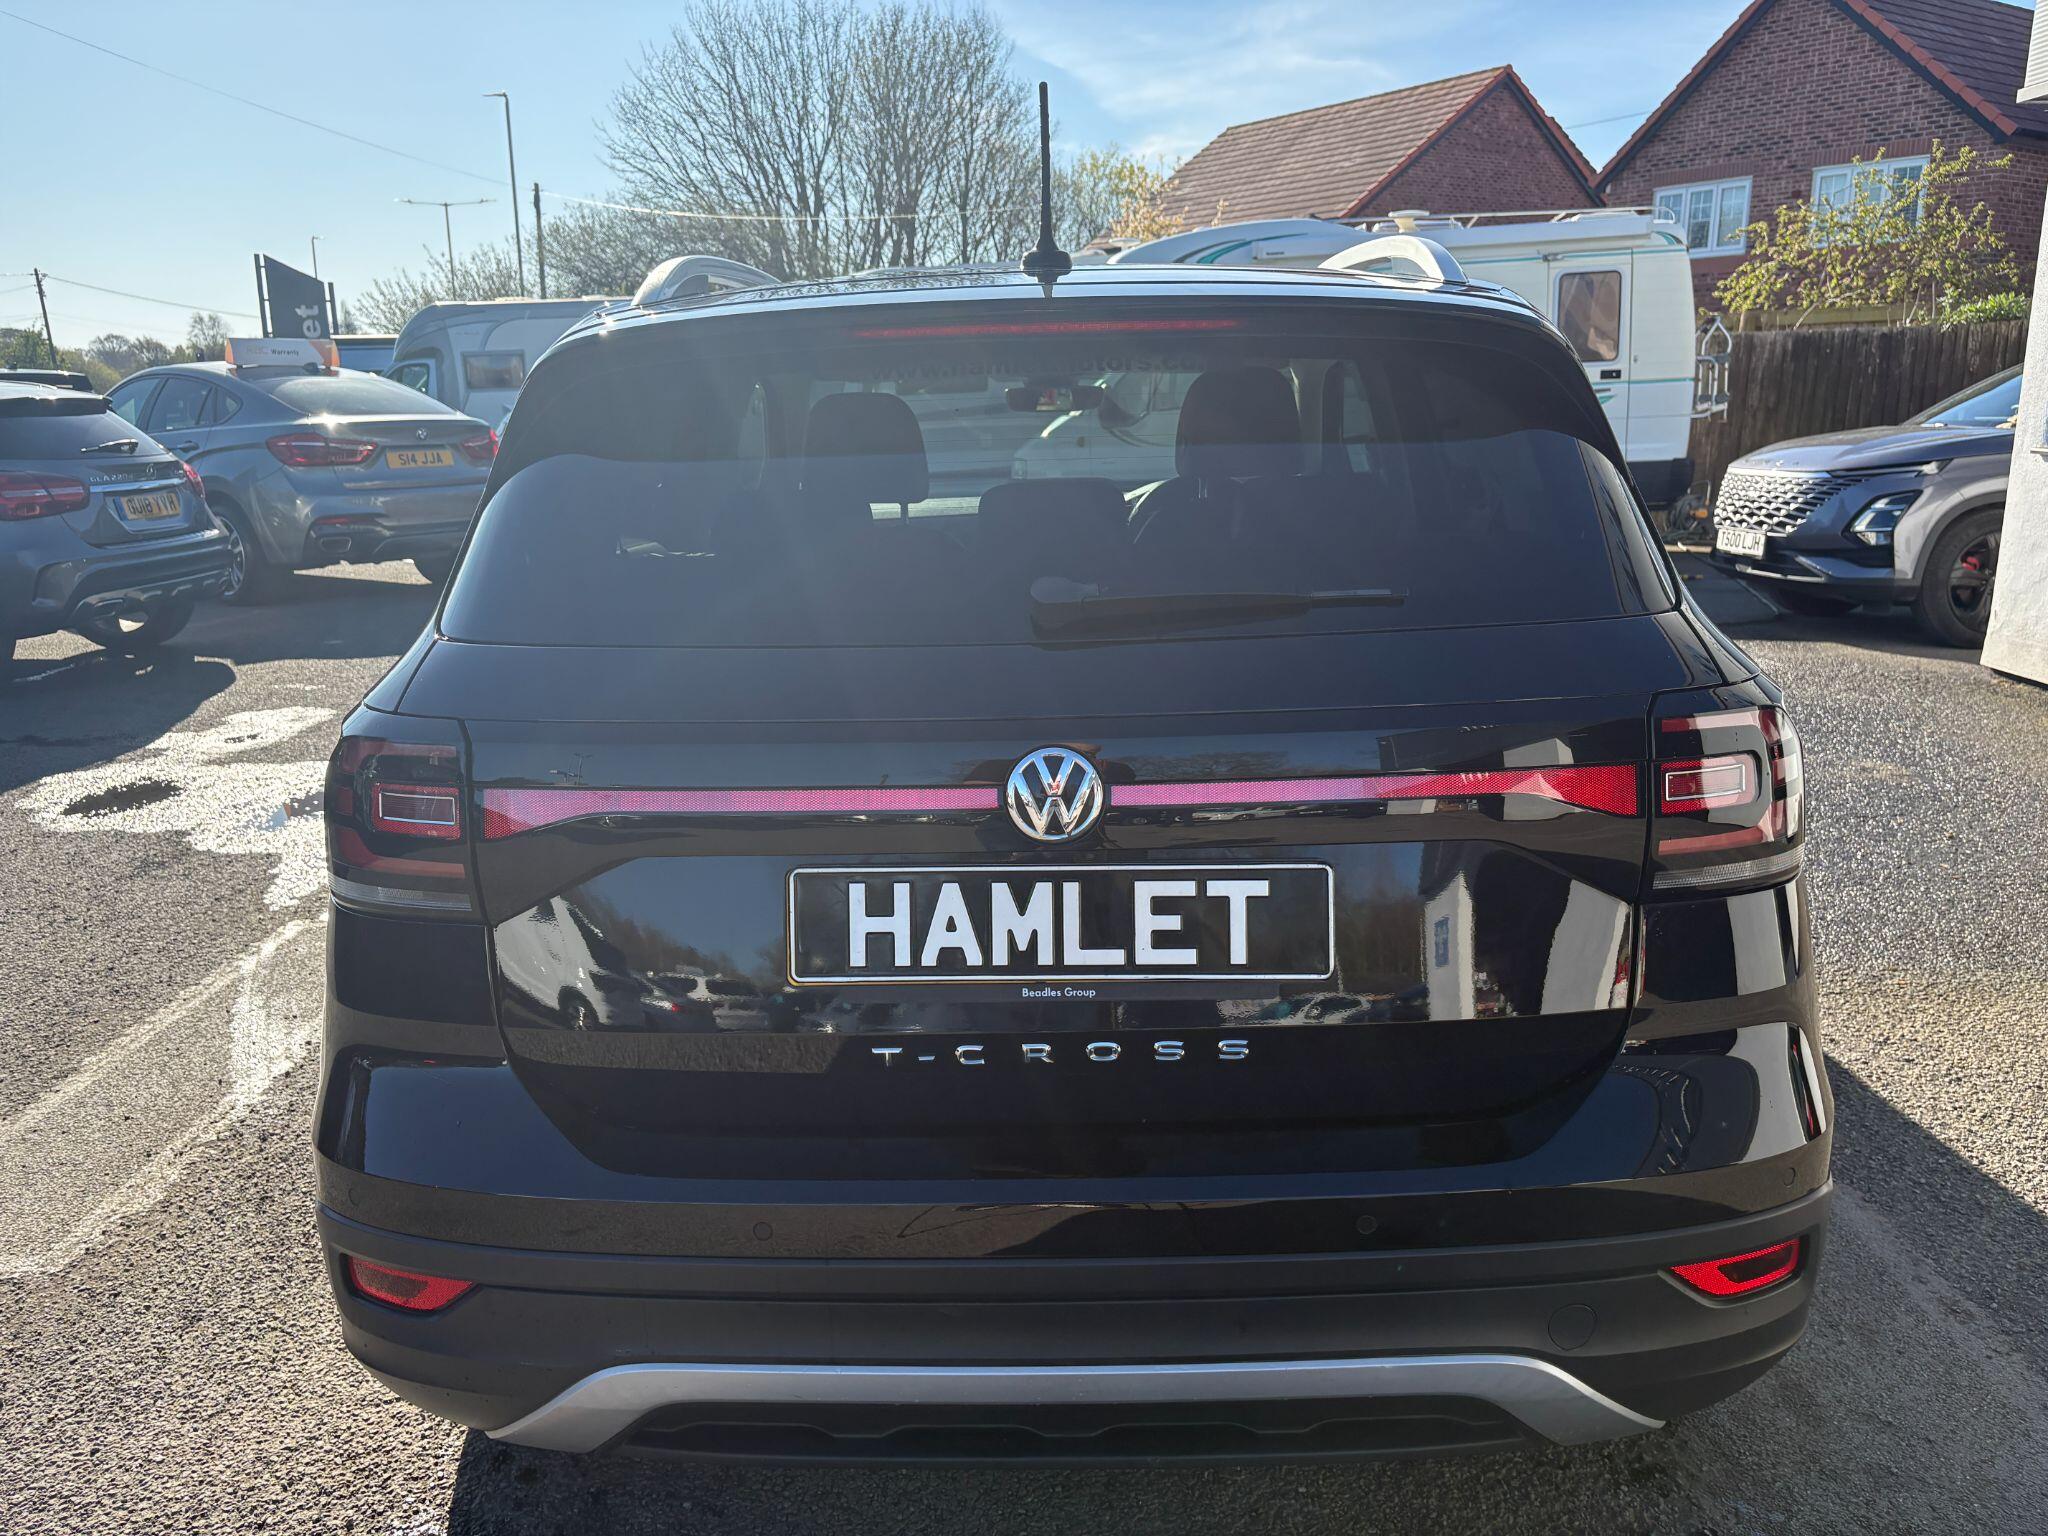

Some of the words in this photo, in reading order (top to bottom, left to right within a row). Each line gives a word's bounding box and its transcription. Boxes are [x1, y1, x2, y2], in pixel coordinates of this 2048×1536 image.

[398, 453, 417, 466] S14
[422, 451, 443, 465] JJA
[1720, 531, 1741, 548] T500
[1741, 534, 1761, 552] LJH
[848, 879, 1270, 968] HAMLET
[1022, 987, 1062, 997] Beadles
[1064, 987, 1096, 998] Group
[871, 1039, 1249, 1067] T-CROSS
